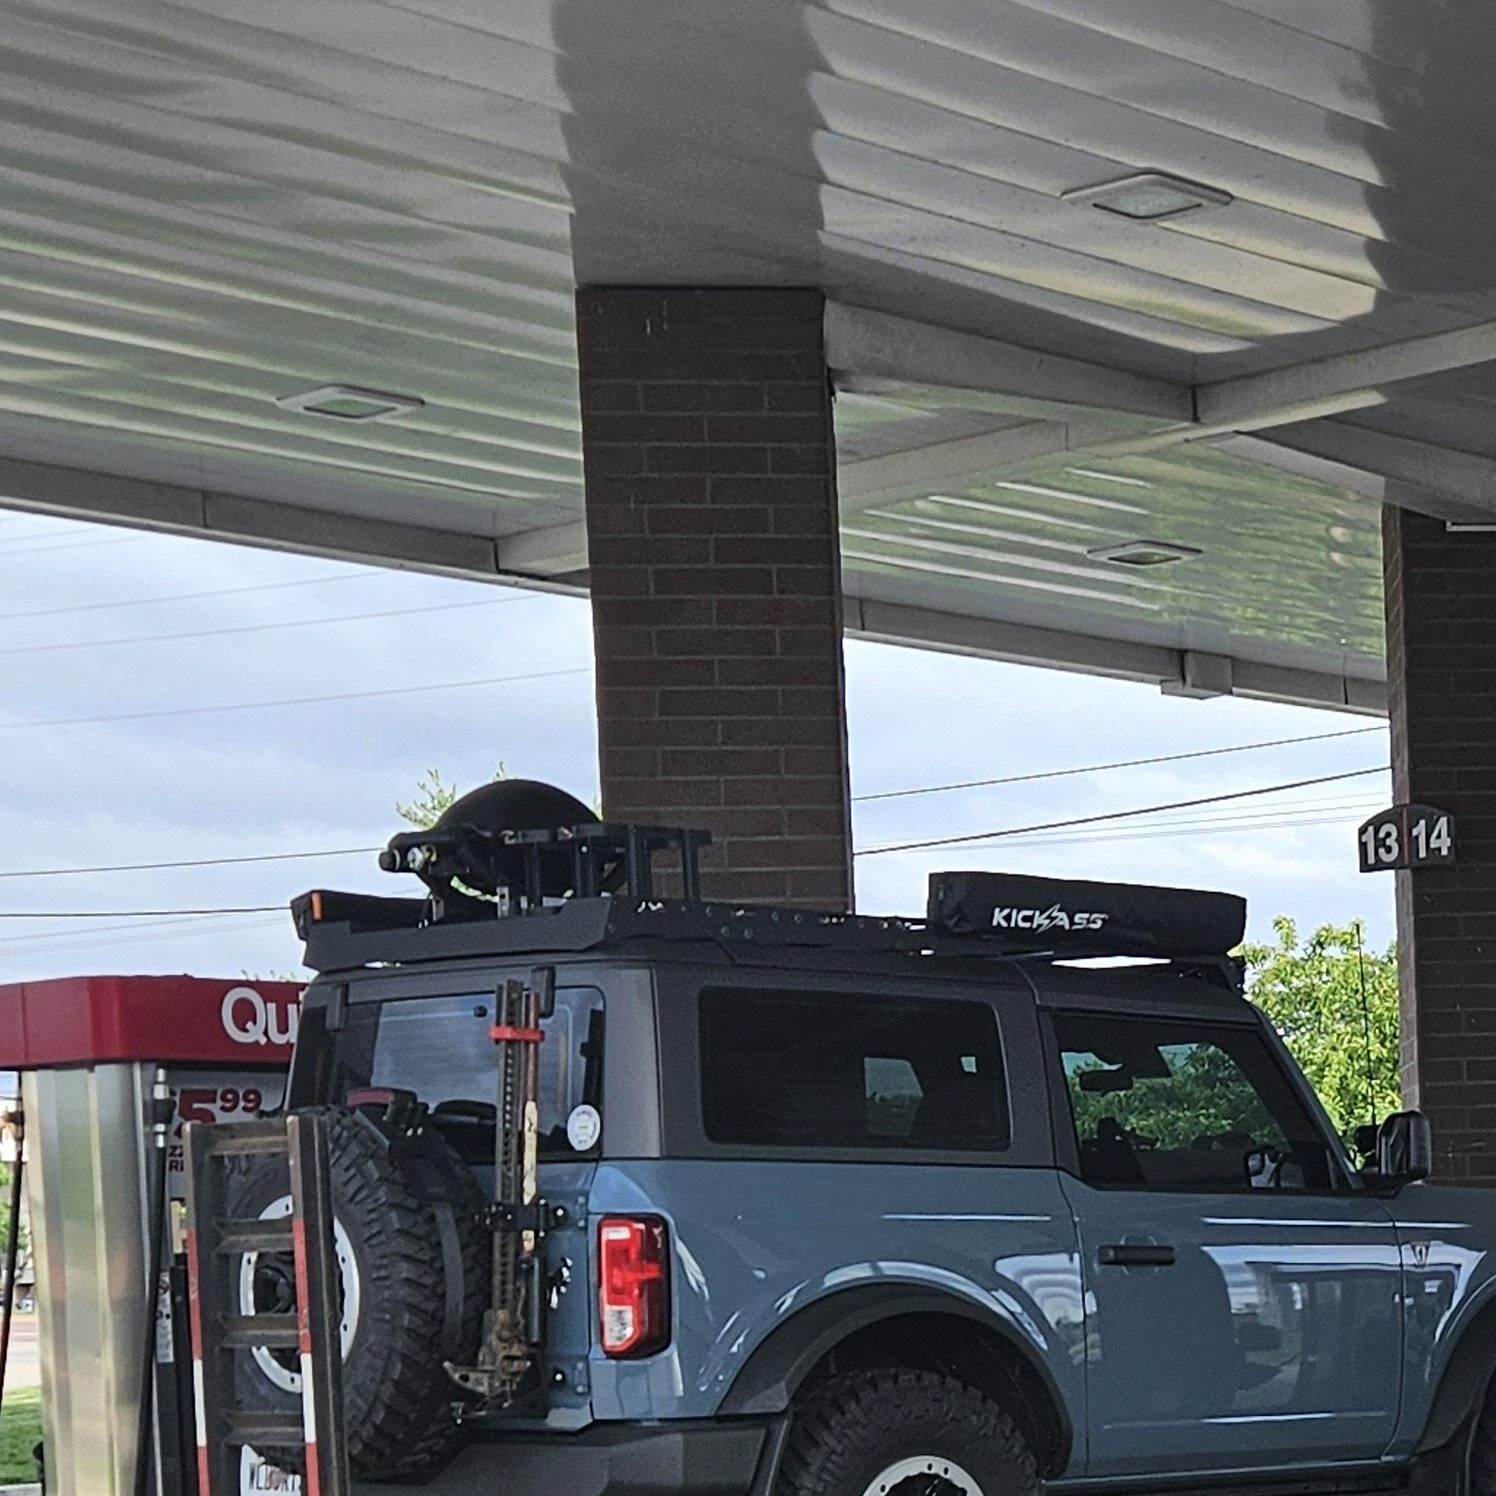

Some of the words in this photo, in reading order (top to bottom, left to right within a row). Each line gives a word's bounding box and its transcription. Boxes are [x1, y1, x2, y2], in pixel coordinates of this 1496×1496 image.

[1361, 823, 1399, 865] 13
[1411, 816, 1451, 859] 14
[992, 904, 1109, 933] KICKASS
[221, 986, 306, 1046] Qu
